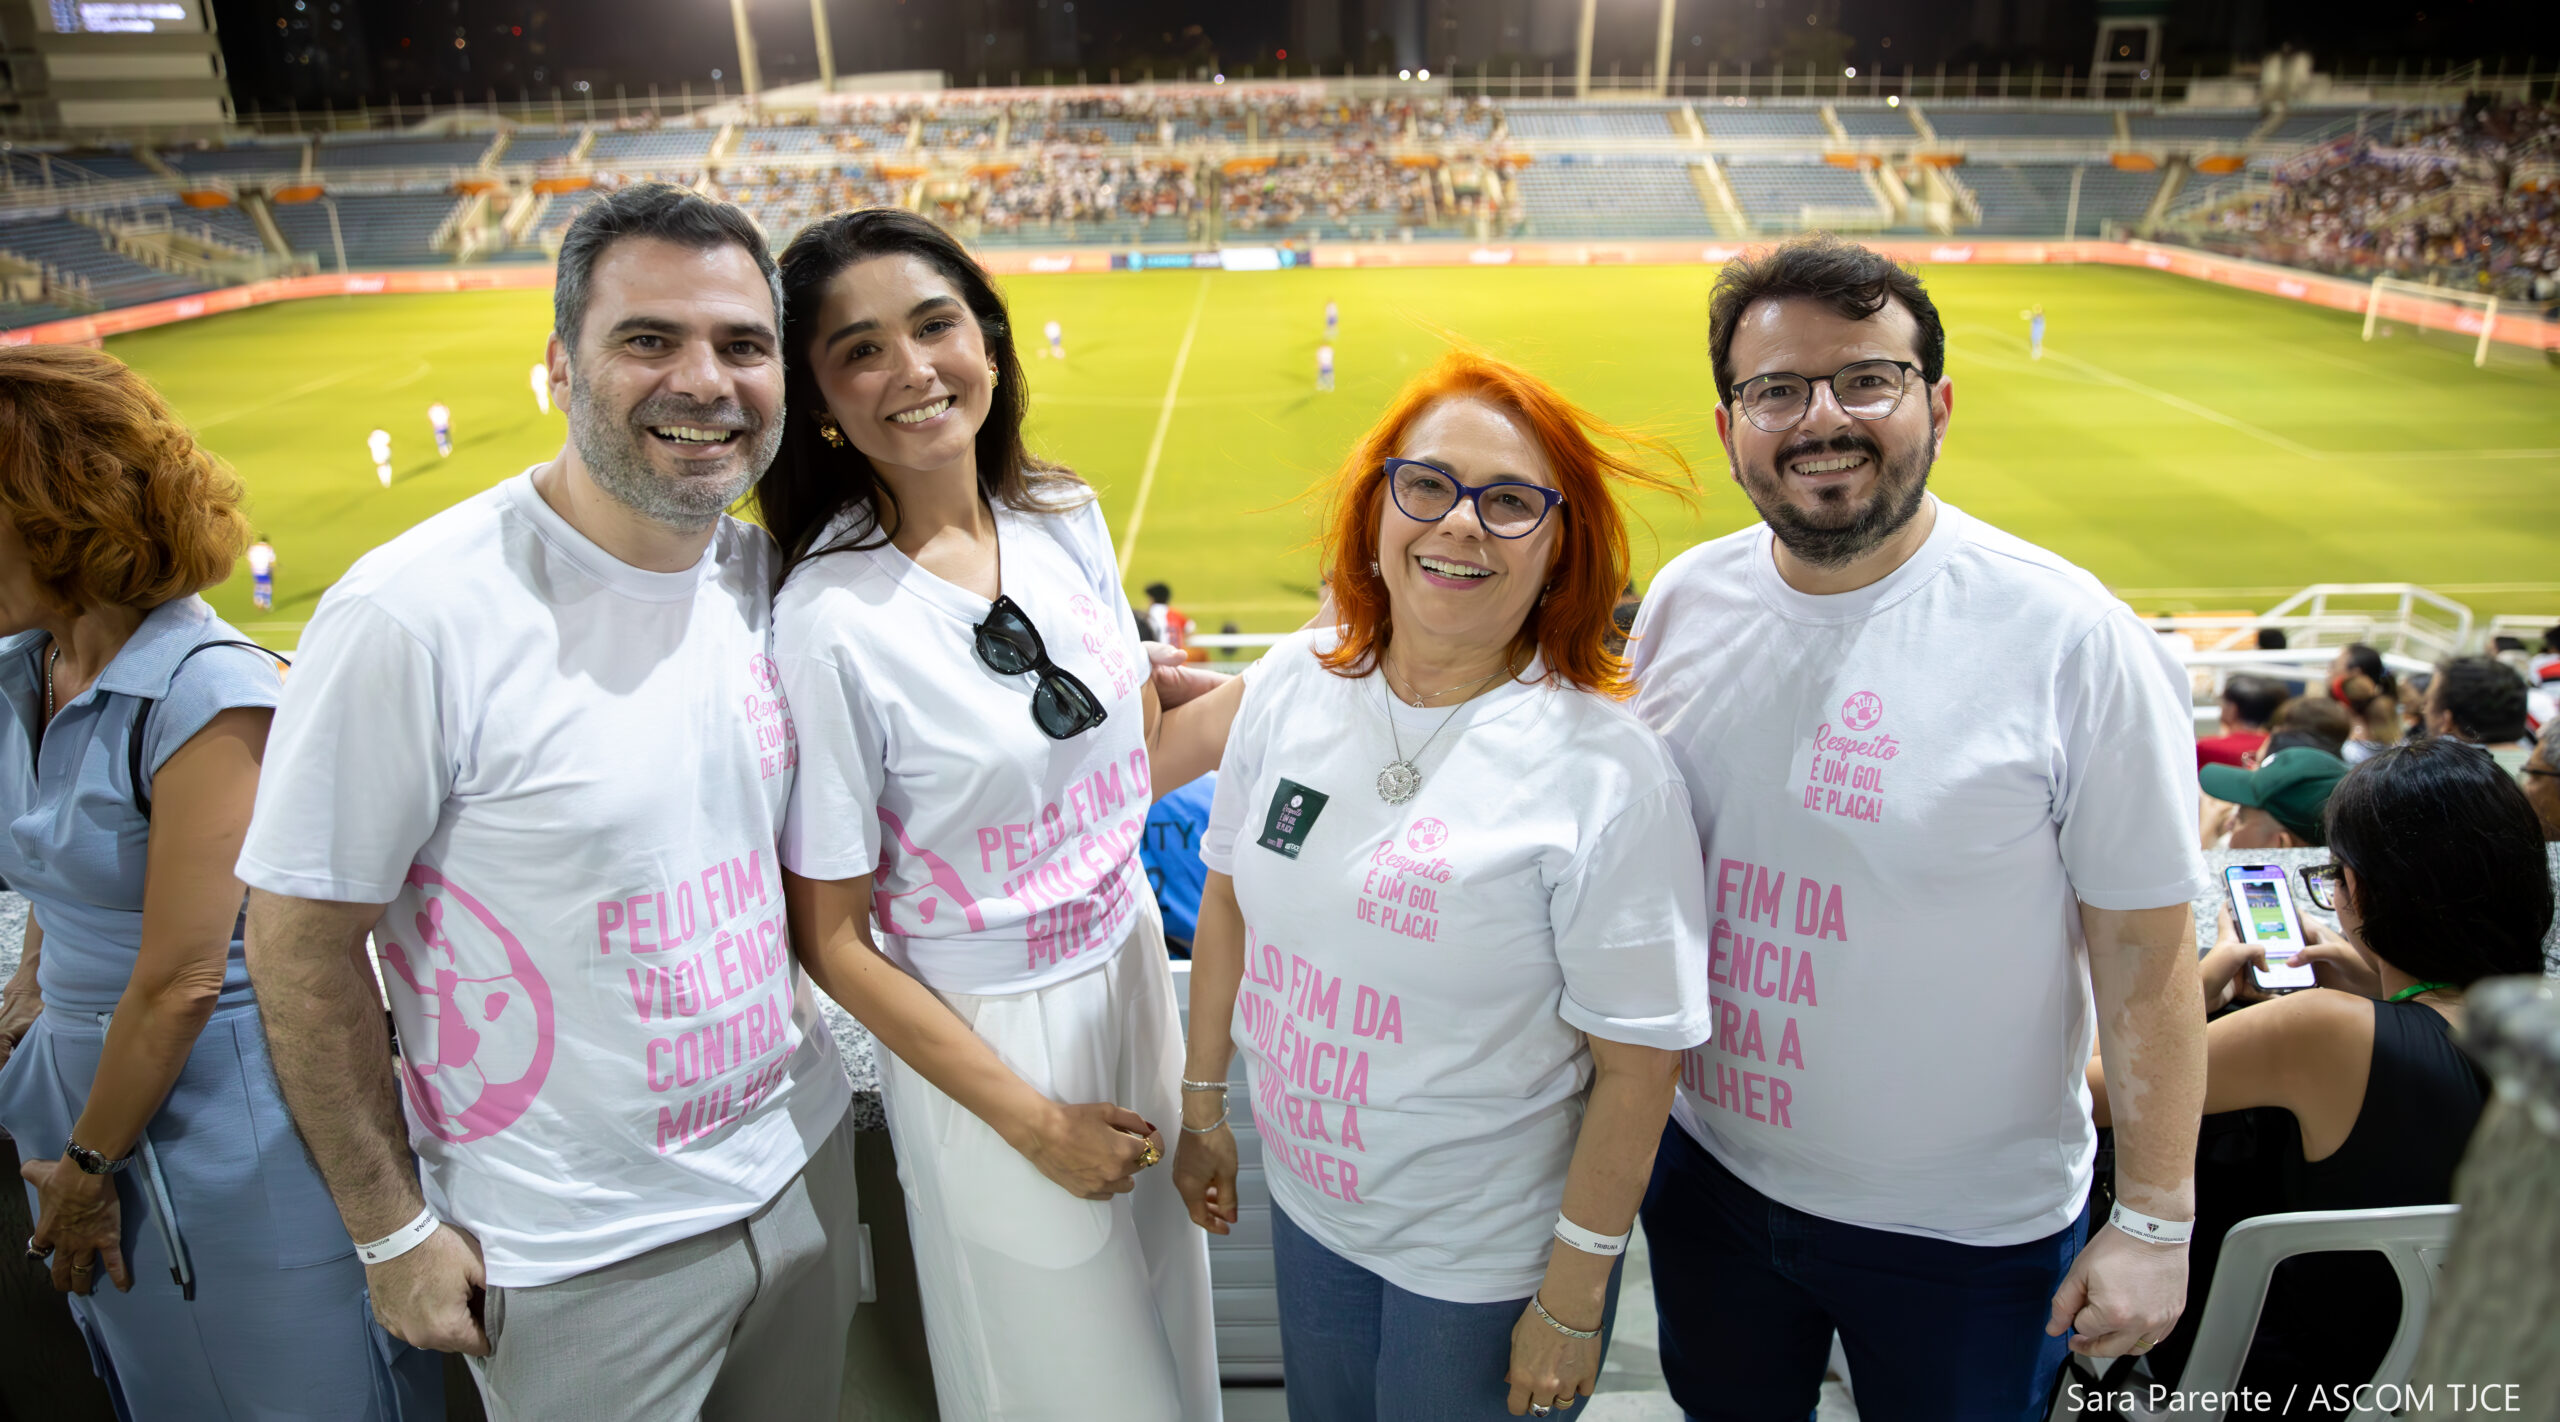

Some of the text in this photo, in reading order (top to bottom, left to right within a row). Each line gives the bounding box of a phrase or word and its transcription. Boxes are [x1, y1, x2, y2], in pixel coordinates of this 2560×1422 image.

[1810, 753, 1884, 793] É UM GOL
[1813, 723, 1900, 761] Respeito
[977, 748, 1150, 873] PELO FIM D
[1804, 785, 1883, 823] DE PLACA!
[1363, 868, 1439, 914] É UM GOL
[1370, 840, 1454, 883] Respeito
[597, 880, 695, 955] PELO
[701, 850, 767, 929] FIM
[1357, 897, 1439, 942] DE PLACA!
[1716, 858, 1848, 941] FIM DA
[1246, 930, 1403, 1044] LO FIM DA
[1708, 918, 1818, 1006] ÊNCIA
[646, 993, 786, 1092] CONTRA
[1239, 985, 1369, 1105] VIOLÊNCIA
[1777, 1017, 1804, 1070] A
[1680, 1050, 1793, 1128] ULHER
[1342, 1104, 1365, 1152] A
